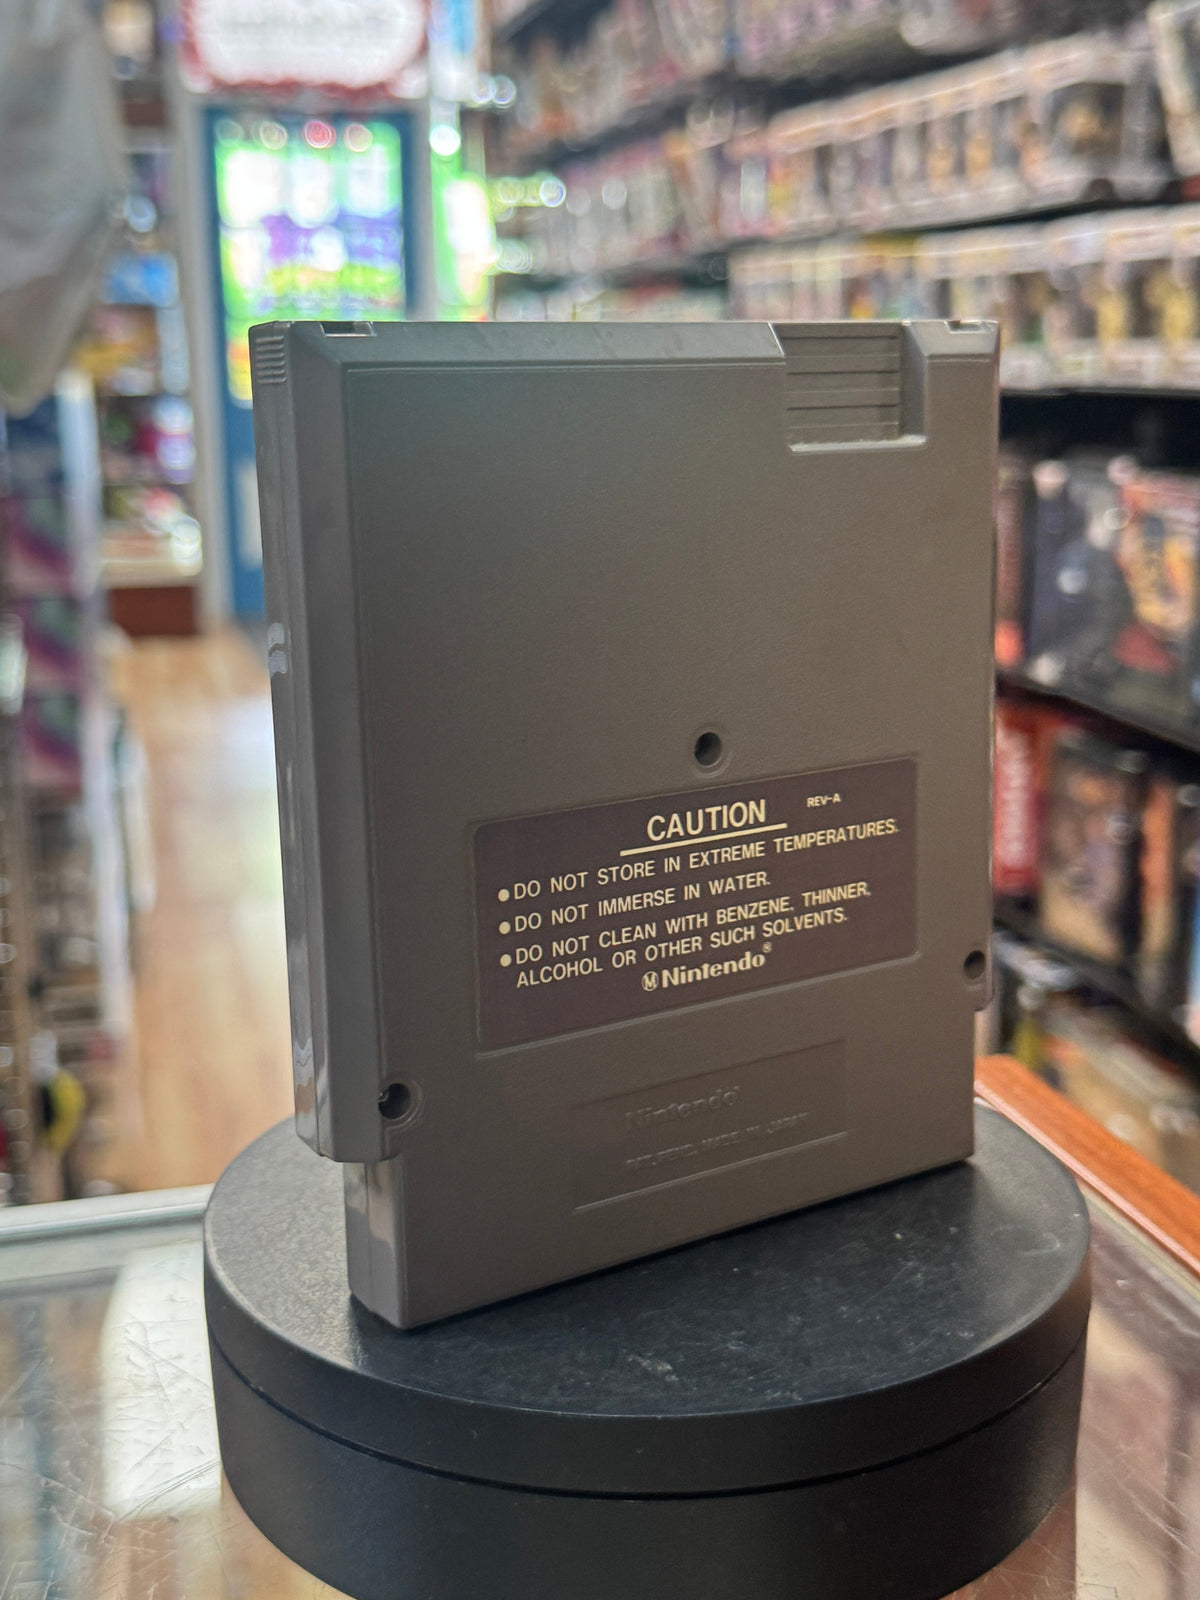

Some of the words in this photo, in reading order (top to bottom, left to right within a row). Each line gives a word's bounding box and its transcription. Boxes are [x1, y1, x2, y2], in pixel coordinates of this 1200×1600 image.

[646, 798, 767, 842] CAUTION
[806, 792, 842, 808] REV-A
[513, 879, 542, 900] DO
[550, 871, 589, 894] NOT
[597, 859, 656, 886] STORE
[663, 855, 681, 874] IN
[688, 840, 767, 869] EXTREME
[772, 817, 900, 854] TEMPERATURES.
[514, 912, 543, 933] DO
[551, 903, 590, 926] NOT
[598, 887, 677, 917] IMMERSE
[683, 882, 701, 901] IN
[708, 870, 772, 896] WATER.
[515, 944, 543, 965] DO
[551, 934, 591, 958] NOT
[598, 921, 657, 949] CLEAN
[664, 911, 709, 935] WITH
[516, 956, 604, 989] ALCOHOL
[611, 949, 637, 969] OR
[644, 936, 703, 962] OTHER
[709, 924, 756, 949] SUCH
[762, 906, 849, 938] SOLVENTS.
